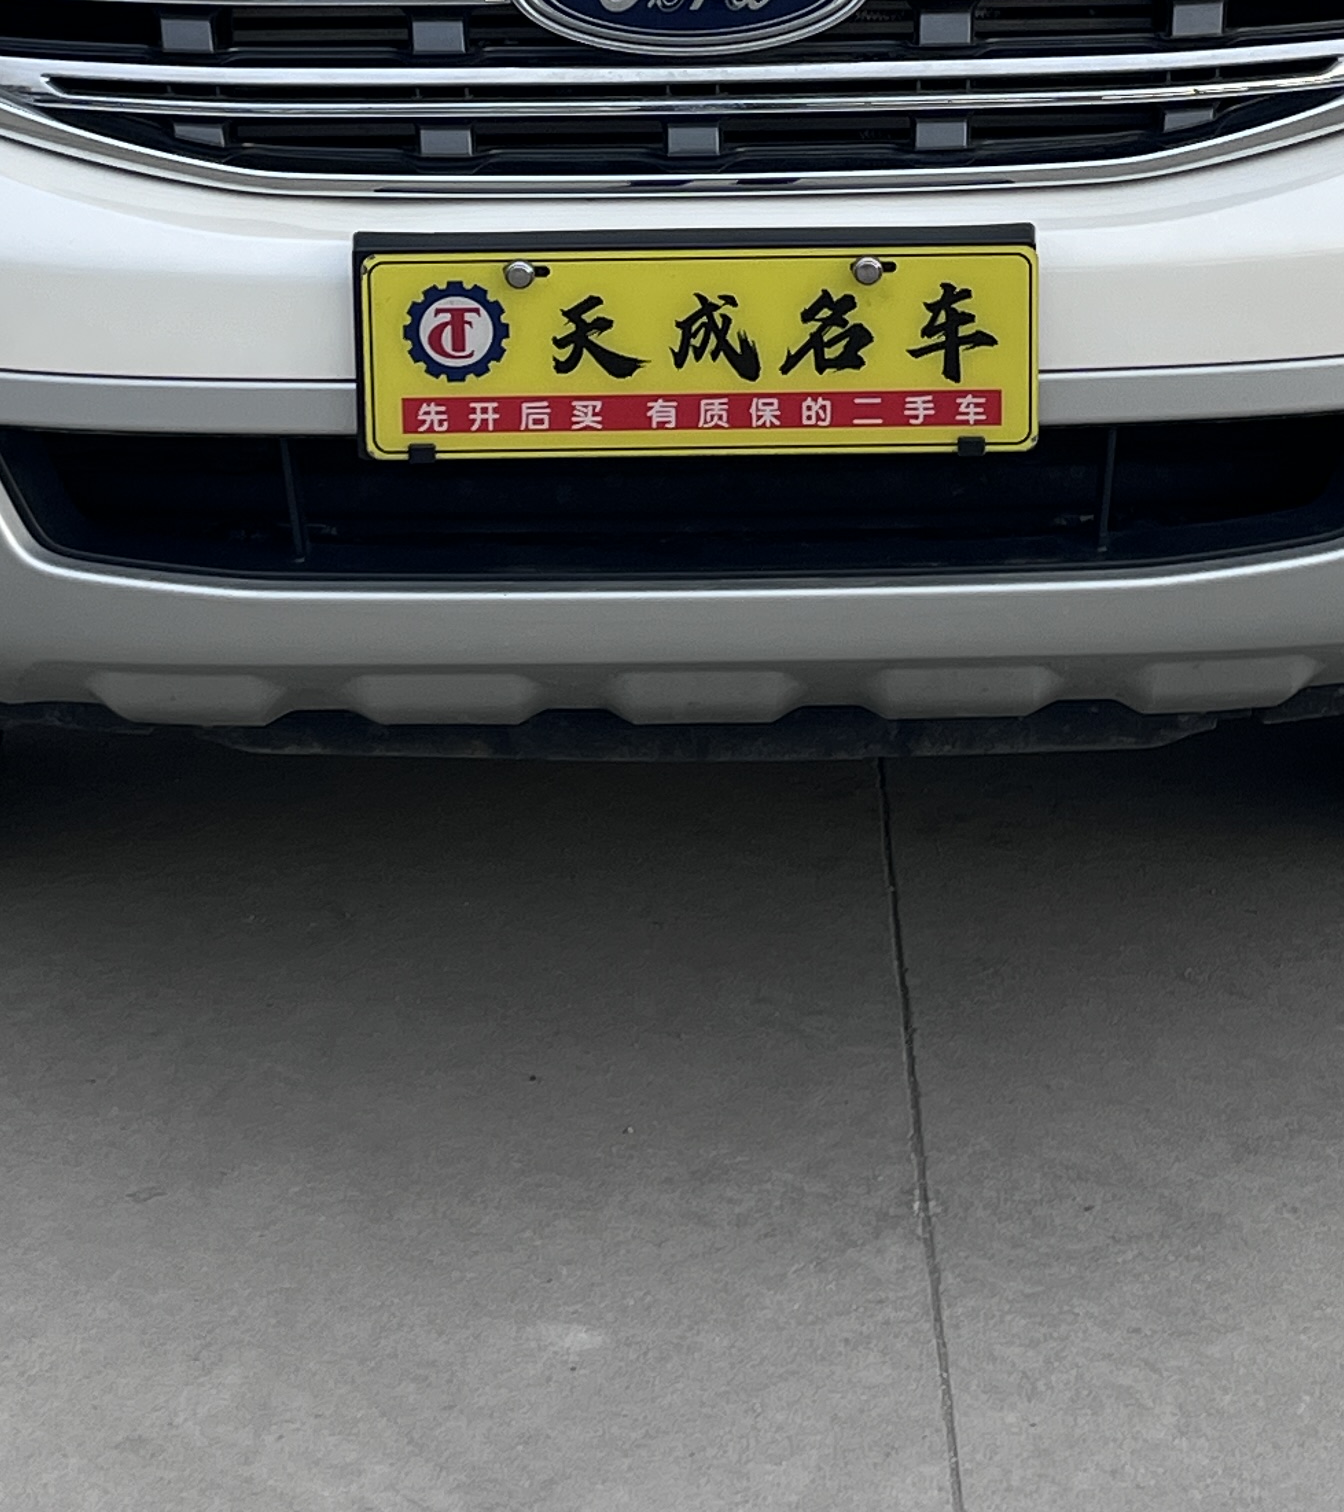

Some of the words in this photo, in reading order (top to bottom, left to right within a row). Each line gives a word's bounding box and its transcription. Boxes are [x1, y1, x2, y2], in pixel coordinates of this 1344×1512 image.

[552, 282, 999, 384] 天成名车
[417, 400, 604, 432] 先开后买
[646, 396, 988, 429] 有质保的二手车
